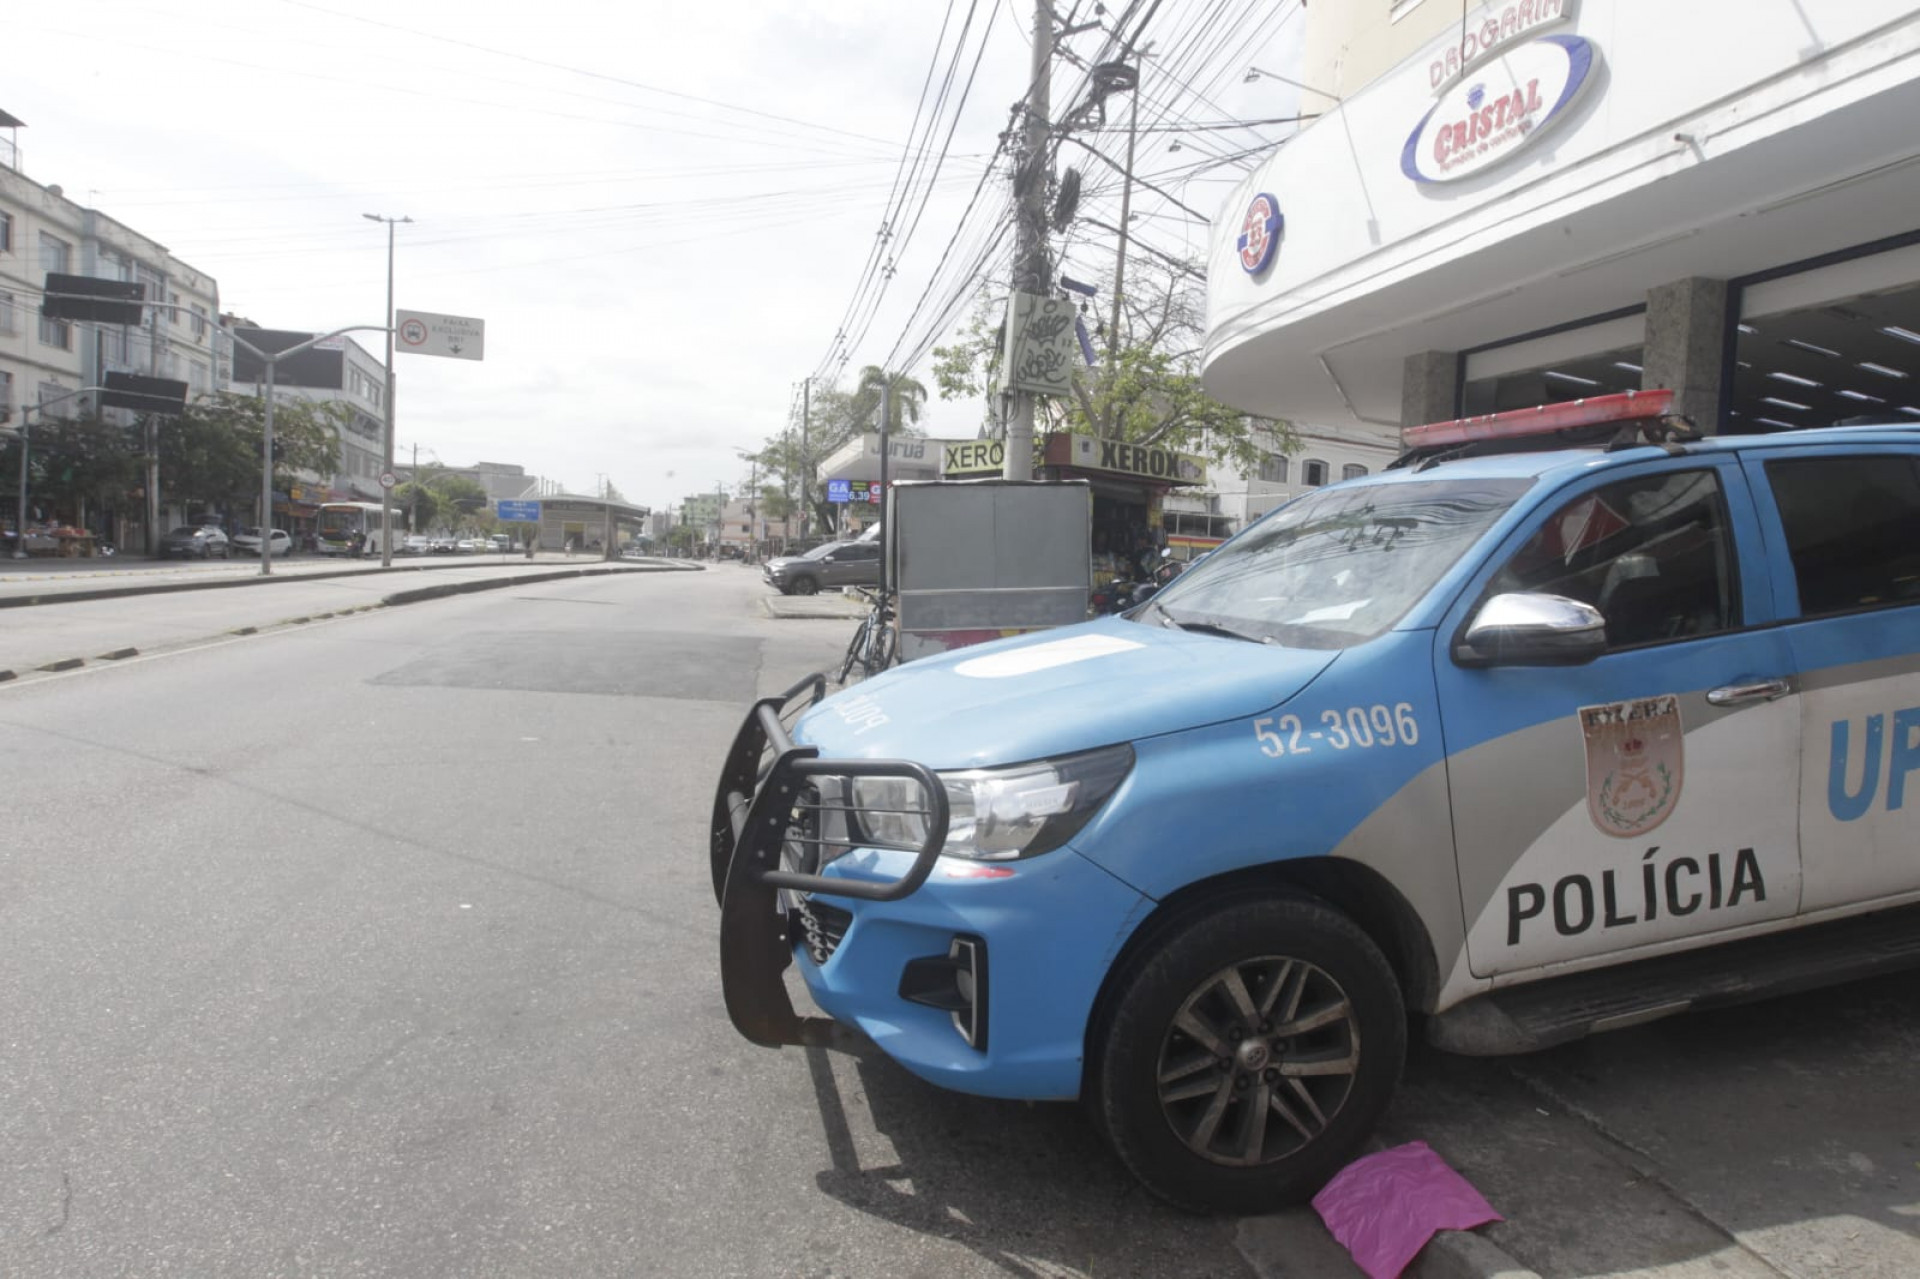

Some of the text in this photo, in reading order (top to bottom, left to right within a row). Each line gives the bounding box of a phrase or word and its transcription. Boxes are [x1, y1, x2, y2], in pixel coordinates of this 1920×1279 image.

[1433, 78, 1544, 164] CRISTAL
[945, 442, 1005, 470] XERO
[1101, 440, 1180, 479] XEROX
[1253, 702, 1419, 758] 52-3096
[1827, 706, 1920, 822] UP
[1506, 846, 1767, 946] POLÍCIA
